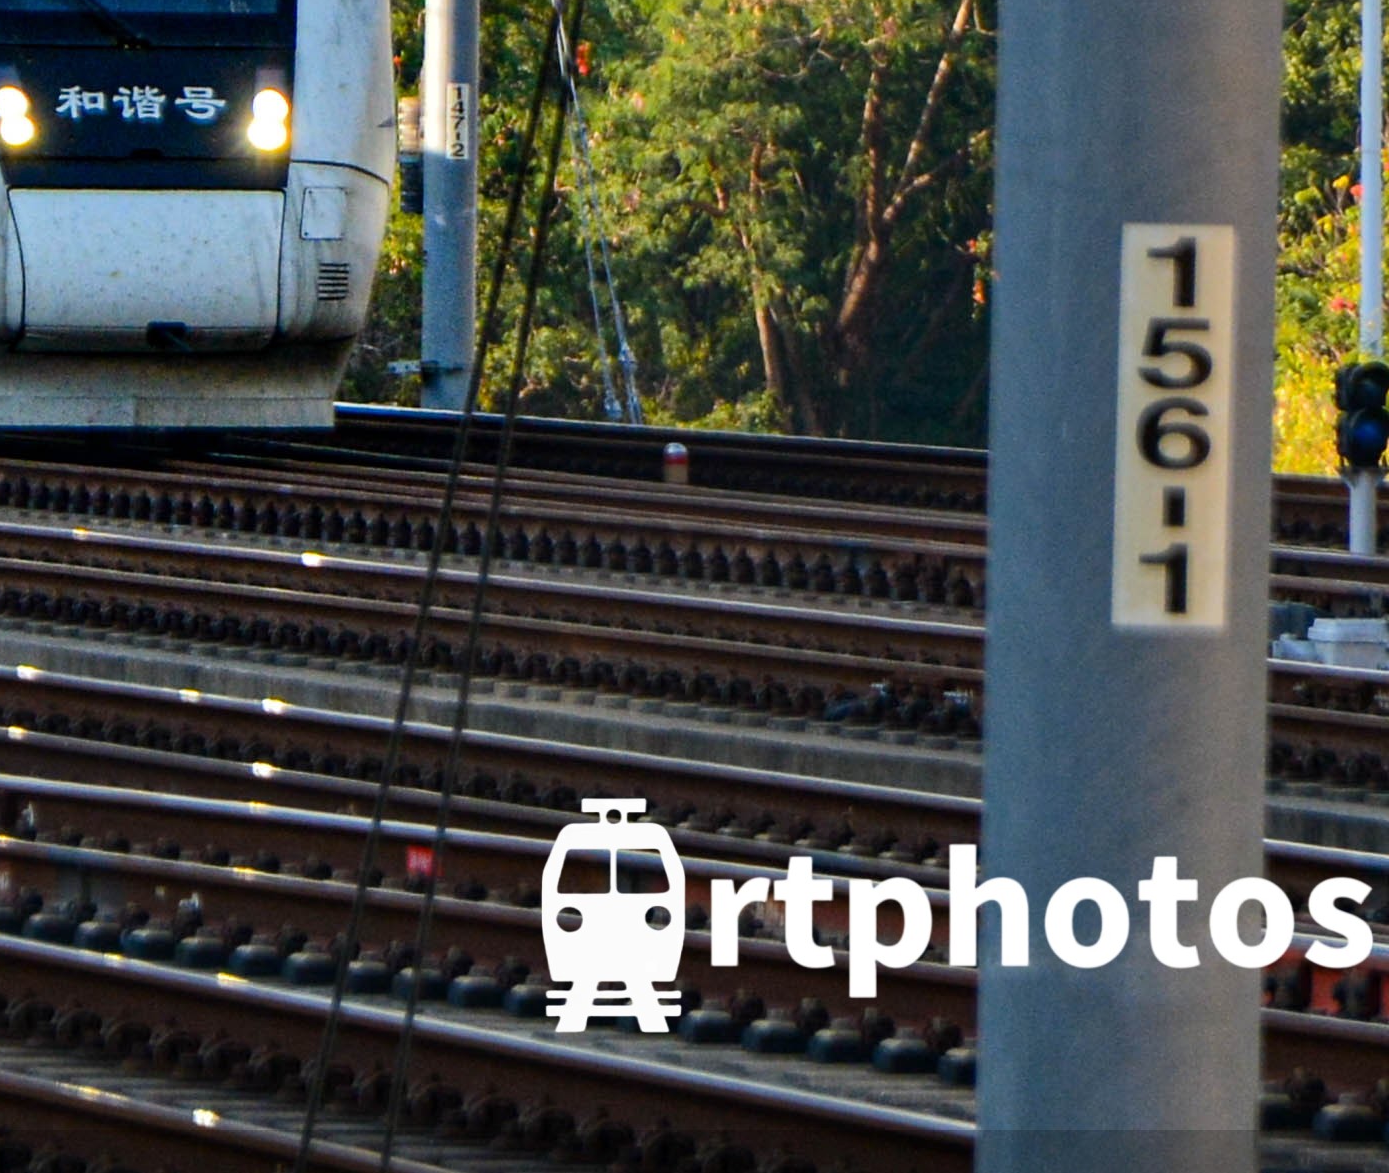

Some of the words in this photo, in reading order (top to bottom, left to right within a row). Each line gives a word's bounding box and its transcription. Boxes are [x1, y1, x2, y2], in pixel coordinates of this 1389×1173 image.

[55, 85, 226, 120] 和谐号
[450, 86, 465, 157] 147-2
[1135, 236, 1214, 615] 156-1
